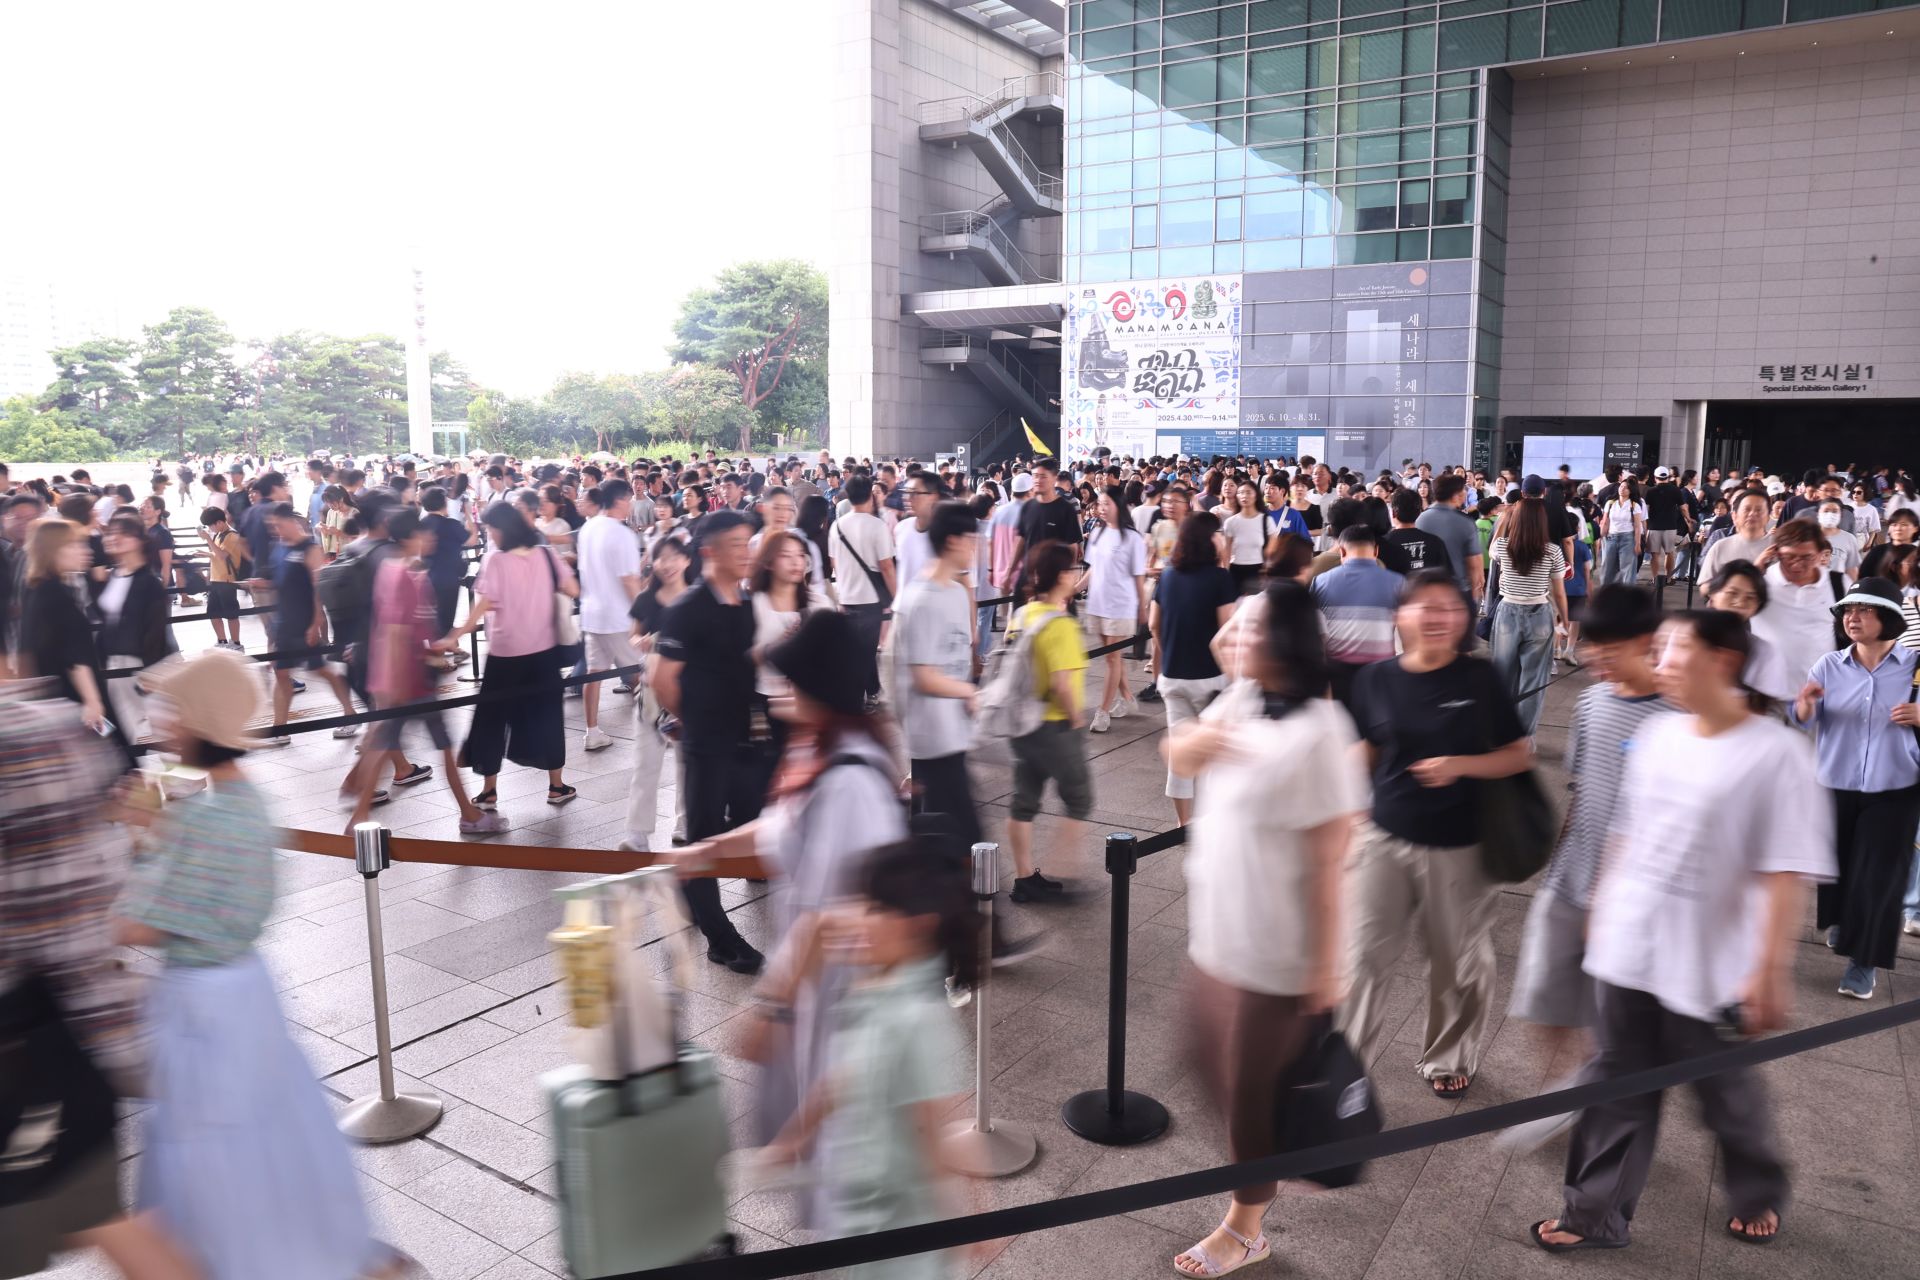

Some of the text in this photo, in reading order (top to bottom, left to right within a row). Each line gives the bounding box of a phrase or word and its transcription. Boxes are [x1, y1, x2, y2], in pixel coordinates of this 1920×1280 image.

[1762, 385, 1791, 393] Special
[1792, 384, 1831, 392] Exhibition
[1832, 384, 1861, 392] Gallery
[957, 446, 965, 458] P
